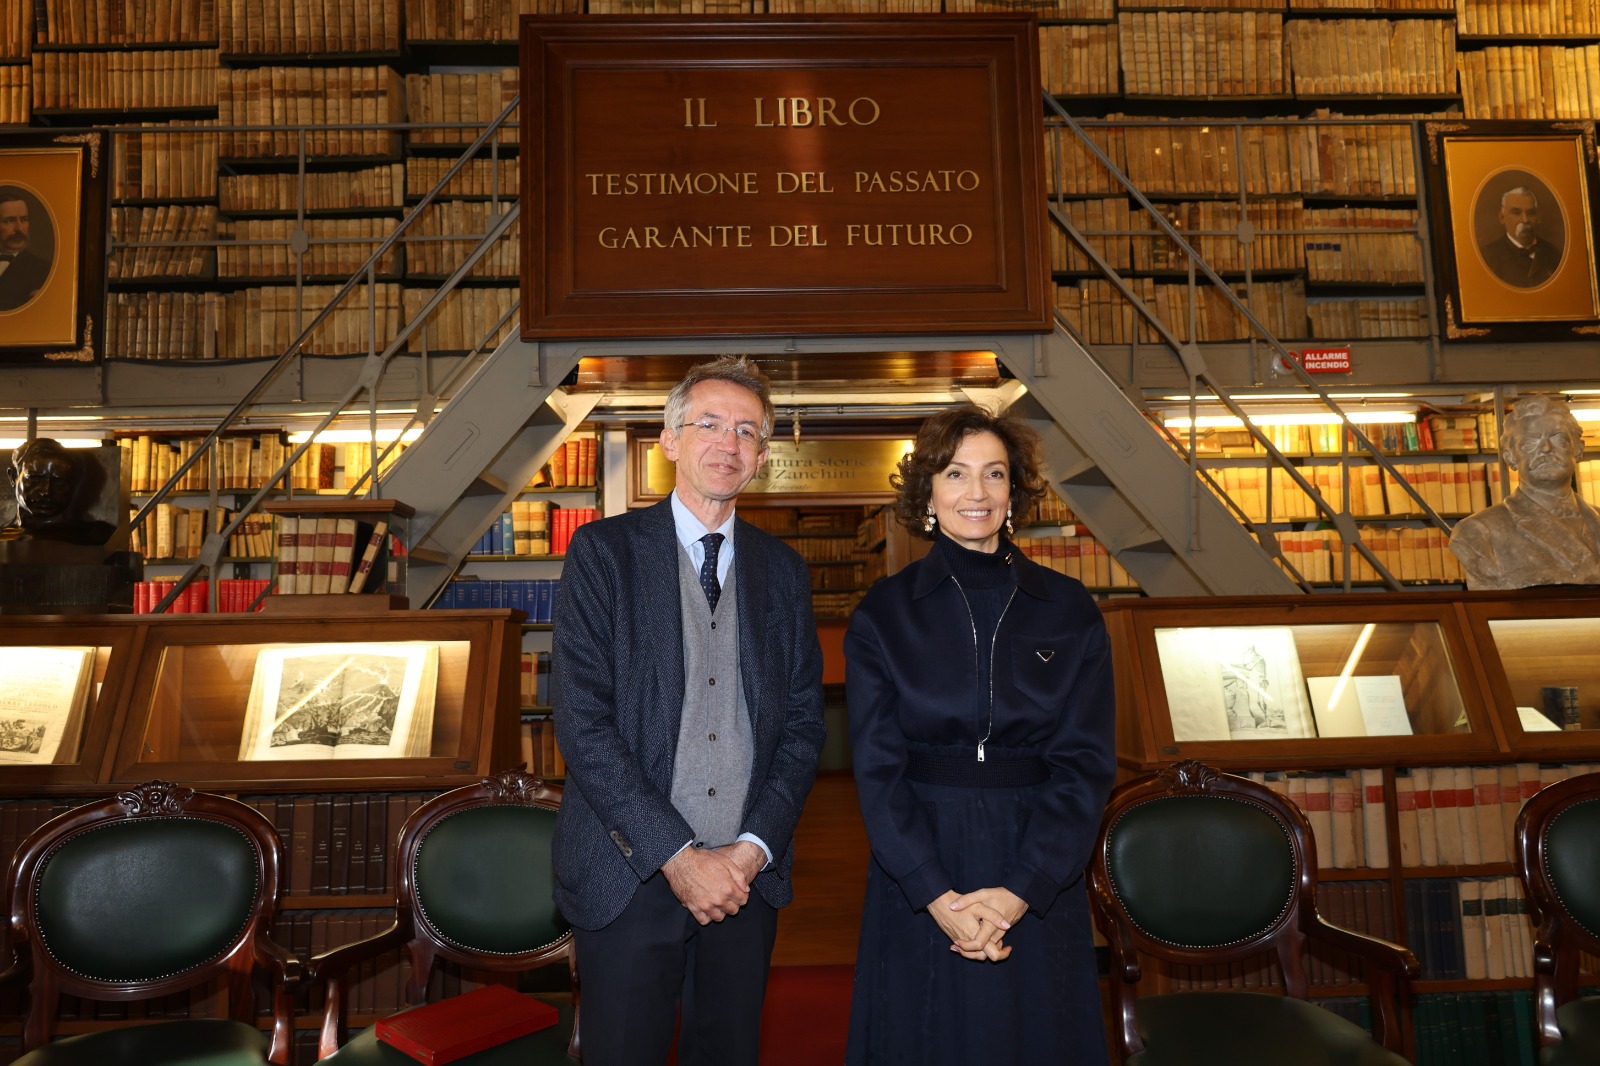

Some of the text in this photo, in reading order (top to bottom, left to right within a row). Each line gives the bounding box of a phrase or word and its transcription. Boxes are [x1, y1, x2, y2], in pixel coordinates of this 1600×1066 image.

[684, 96, 881, 128] IL LIBRO
[586, 170, 980, 195] TESTIMONE DEL PASSATO
[598, 223, 973, 249] GARANTE DEL FUTURO
[1305, 353, 1348, 361] ALLARME
[1305, 361, 1349, 369] INCENDIO
